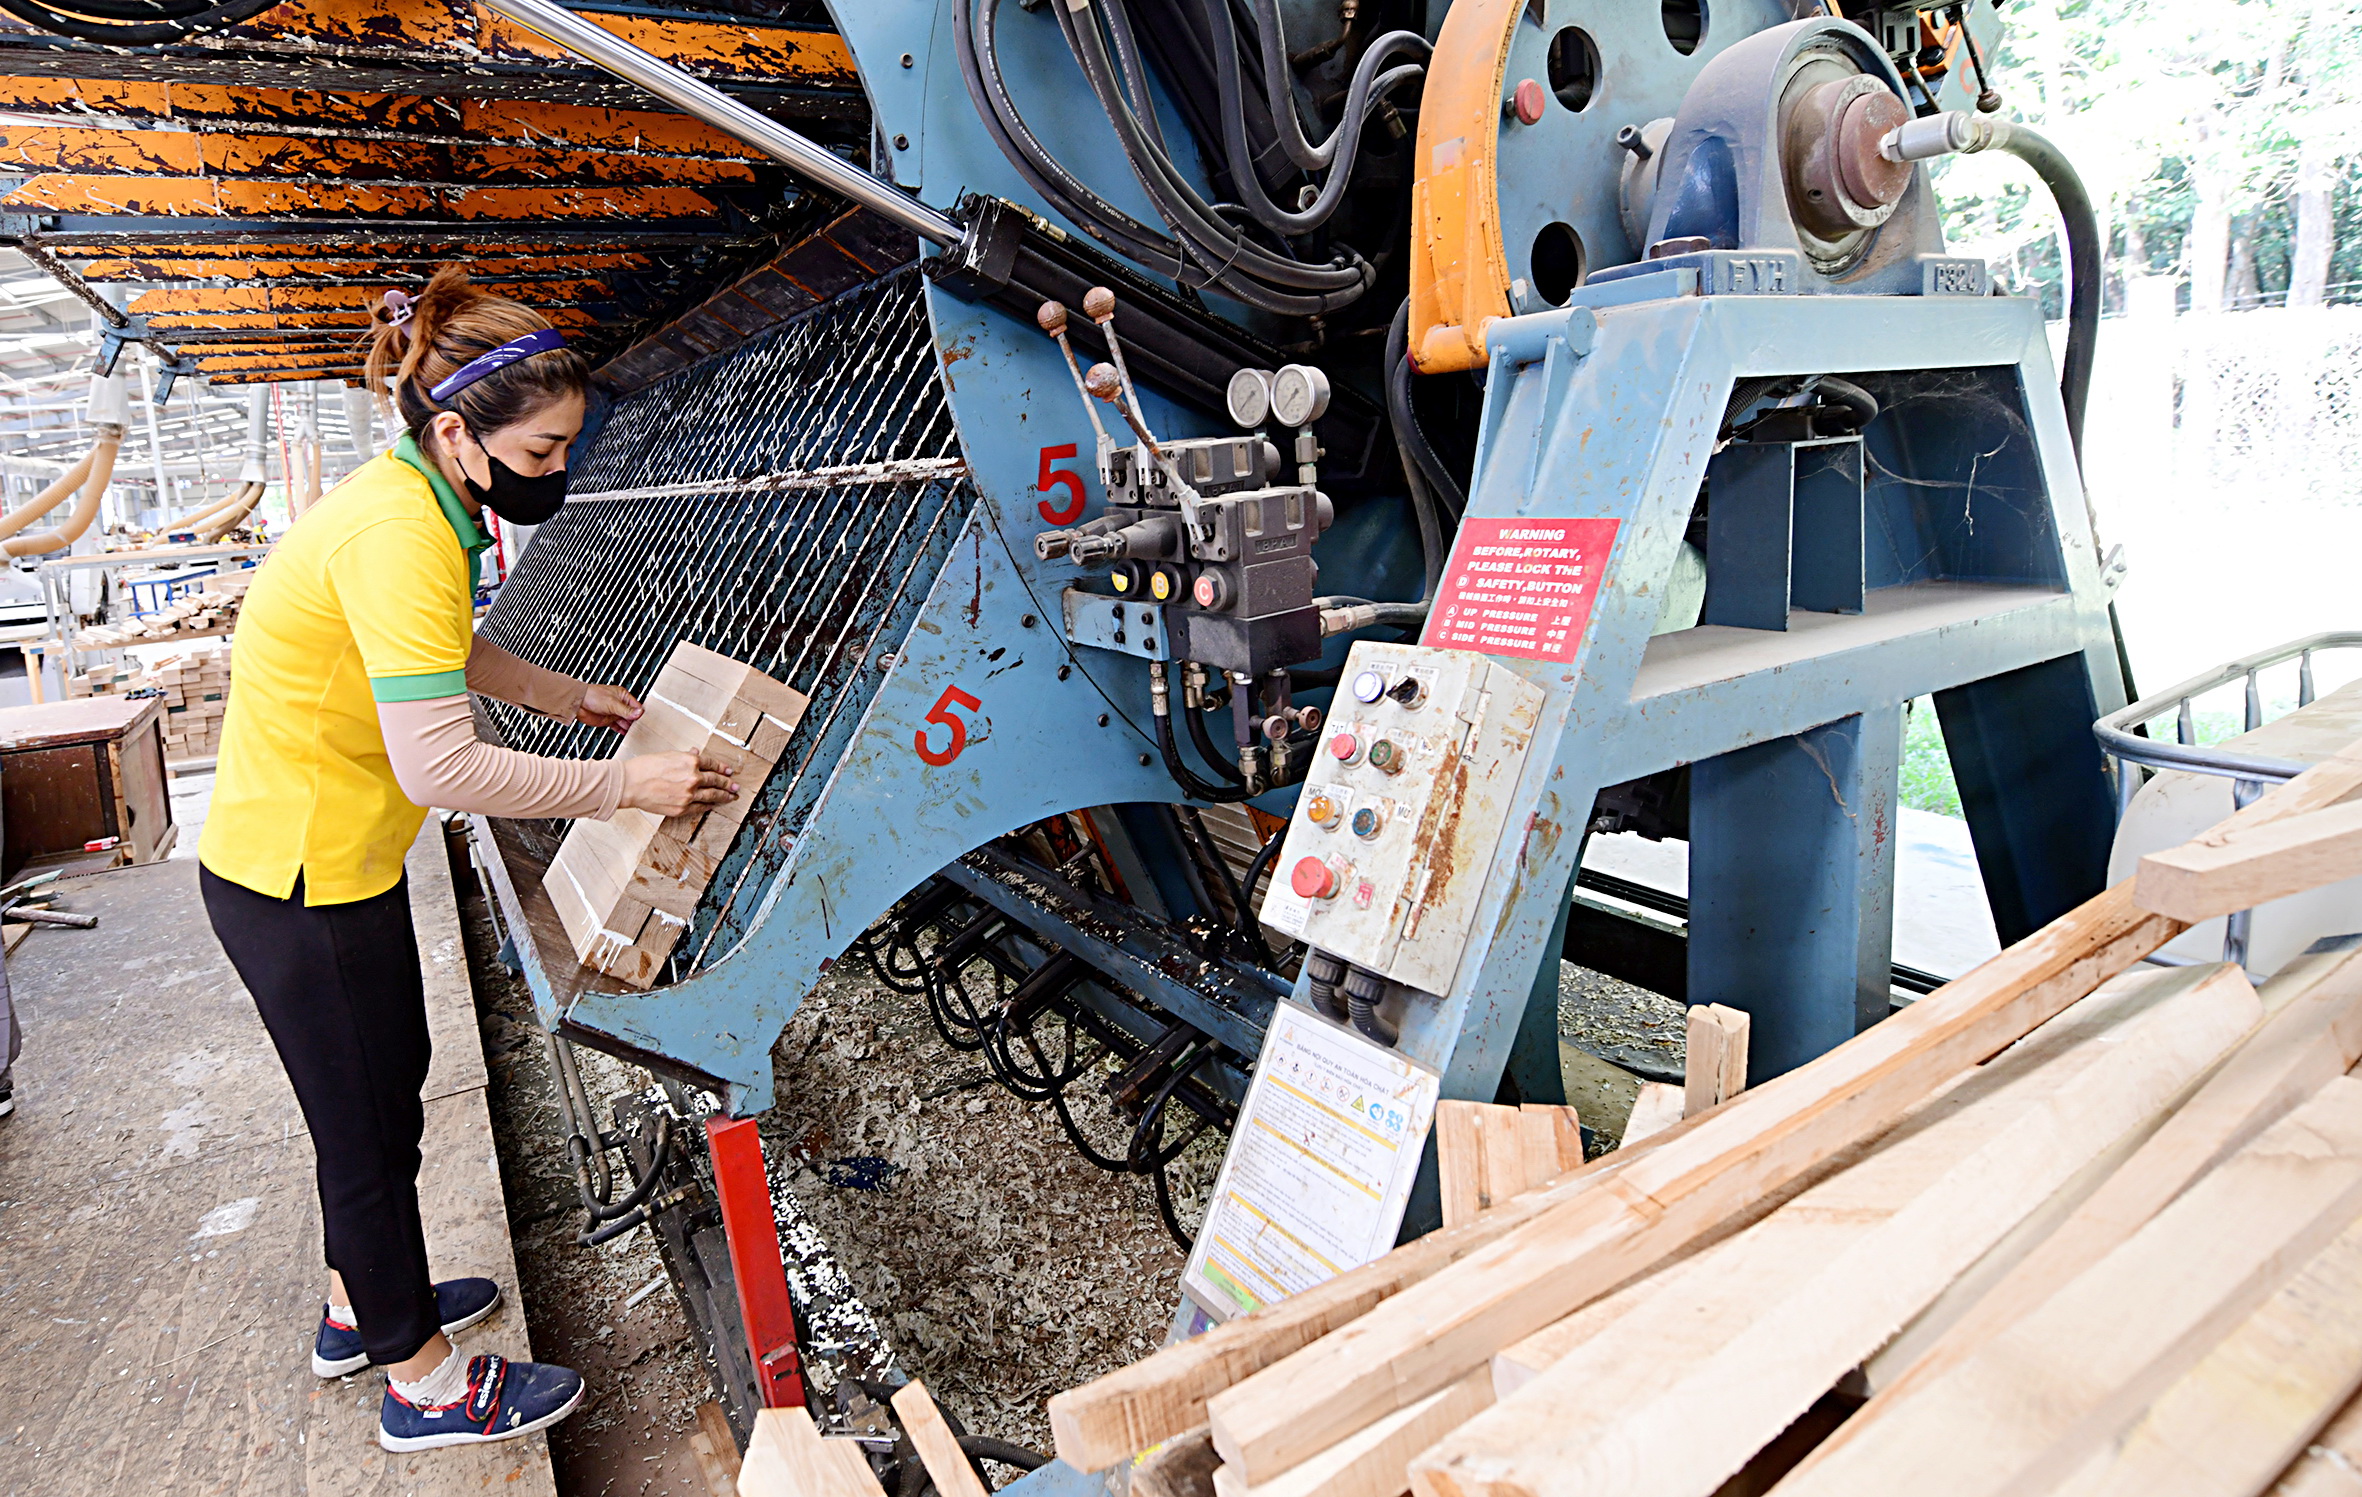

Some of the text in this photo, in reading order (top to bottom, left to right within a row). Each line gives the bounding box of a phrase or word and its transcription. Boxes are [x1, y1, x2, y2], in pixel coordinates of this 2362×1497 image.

[1728, 259, 1786, 292] FYH
[1037, 443, 1086, 526] 5
[1499, 529, 1566, 541] WARNING
[1467, 561, 1583, 576] PLEASE LOCK THE
[1156, 576, 1166, 593] B
[1199, 582, 1209, 600] C
[1463, 607, 1478, 617] UP
[1482, 609, 1539, 622] PRESSURE
[1456, 620, 1476, 629] MID
[1480, 622, 1537, 636] PRESSURE
[1451, 632, 1476, 643] SIDE
[1480, 635, 1537, 650] PRESSURE
[914, 684, 983, 767] 5
